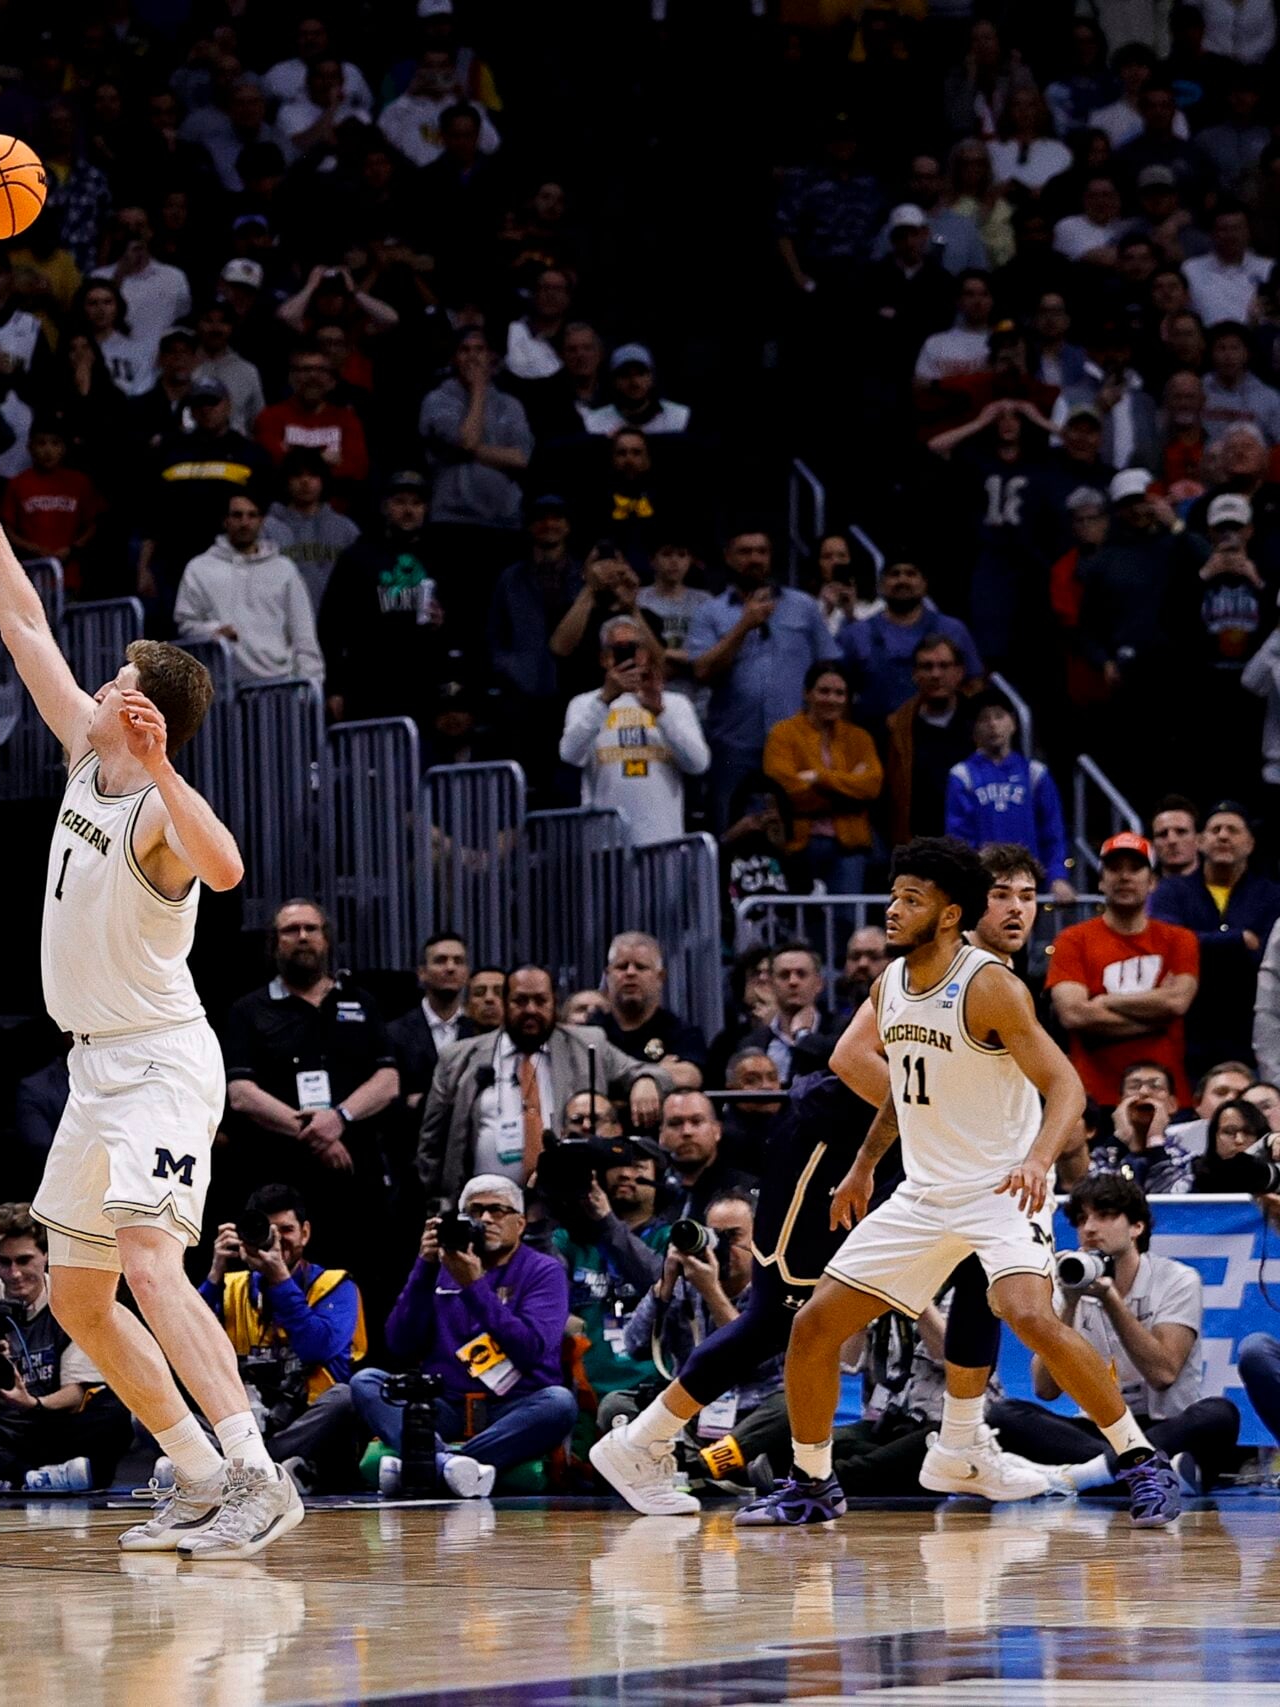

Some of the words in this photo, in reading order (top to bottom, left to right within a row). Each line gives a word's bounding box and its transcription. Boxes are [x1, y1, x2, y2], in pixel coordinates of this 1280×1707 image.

[55, 847, 73, 902] 1
[884, 1023, 954, 1053] MICHIGAN
[902, 1054, 931, 1106] 11
[152, 1146, 197, 1188] M
